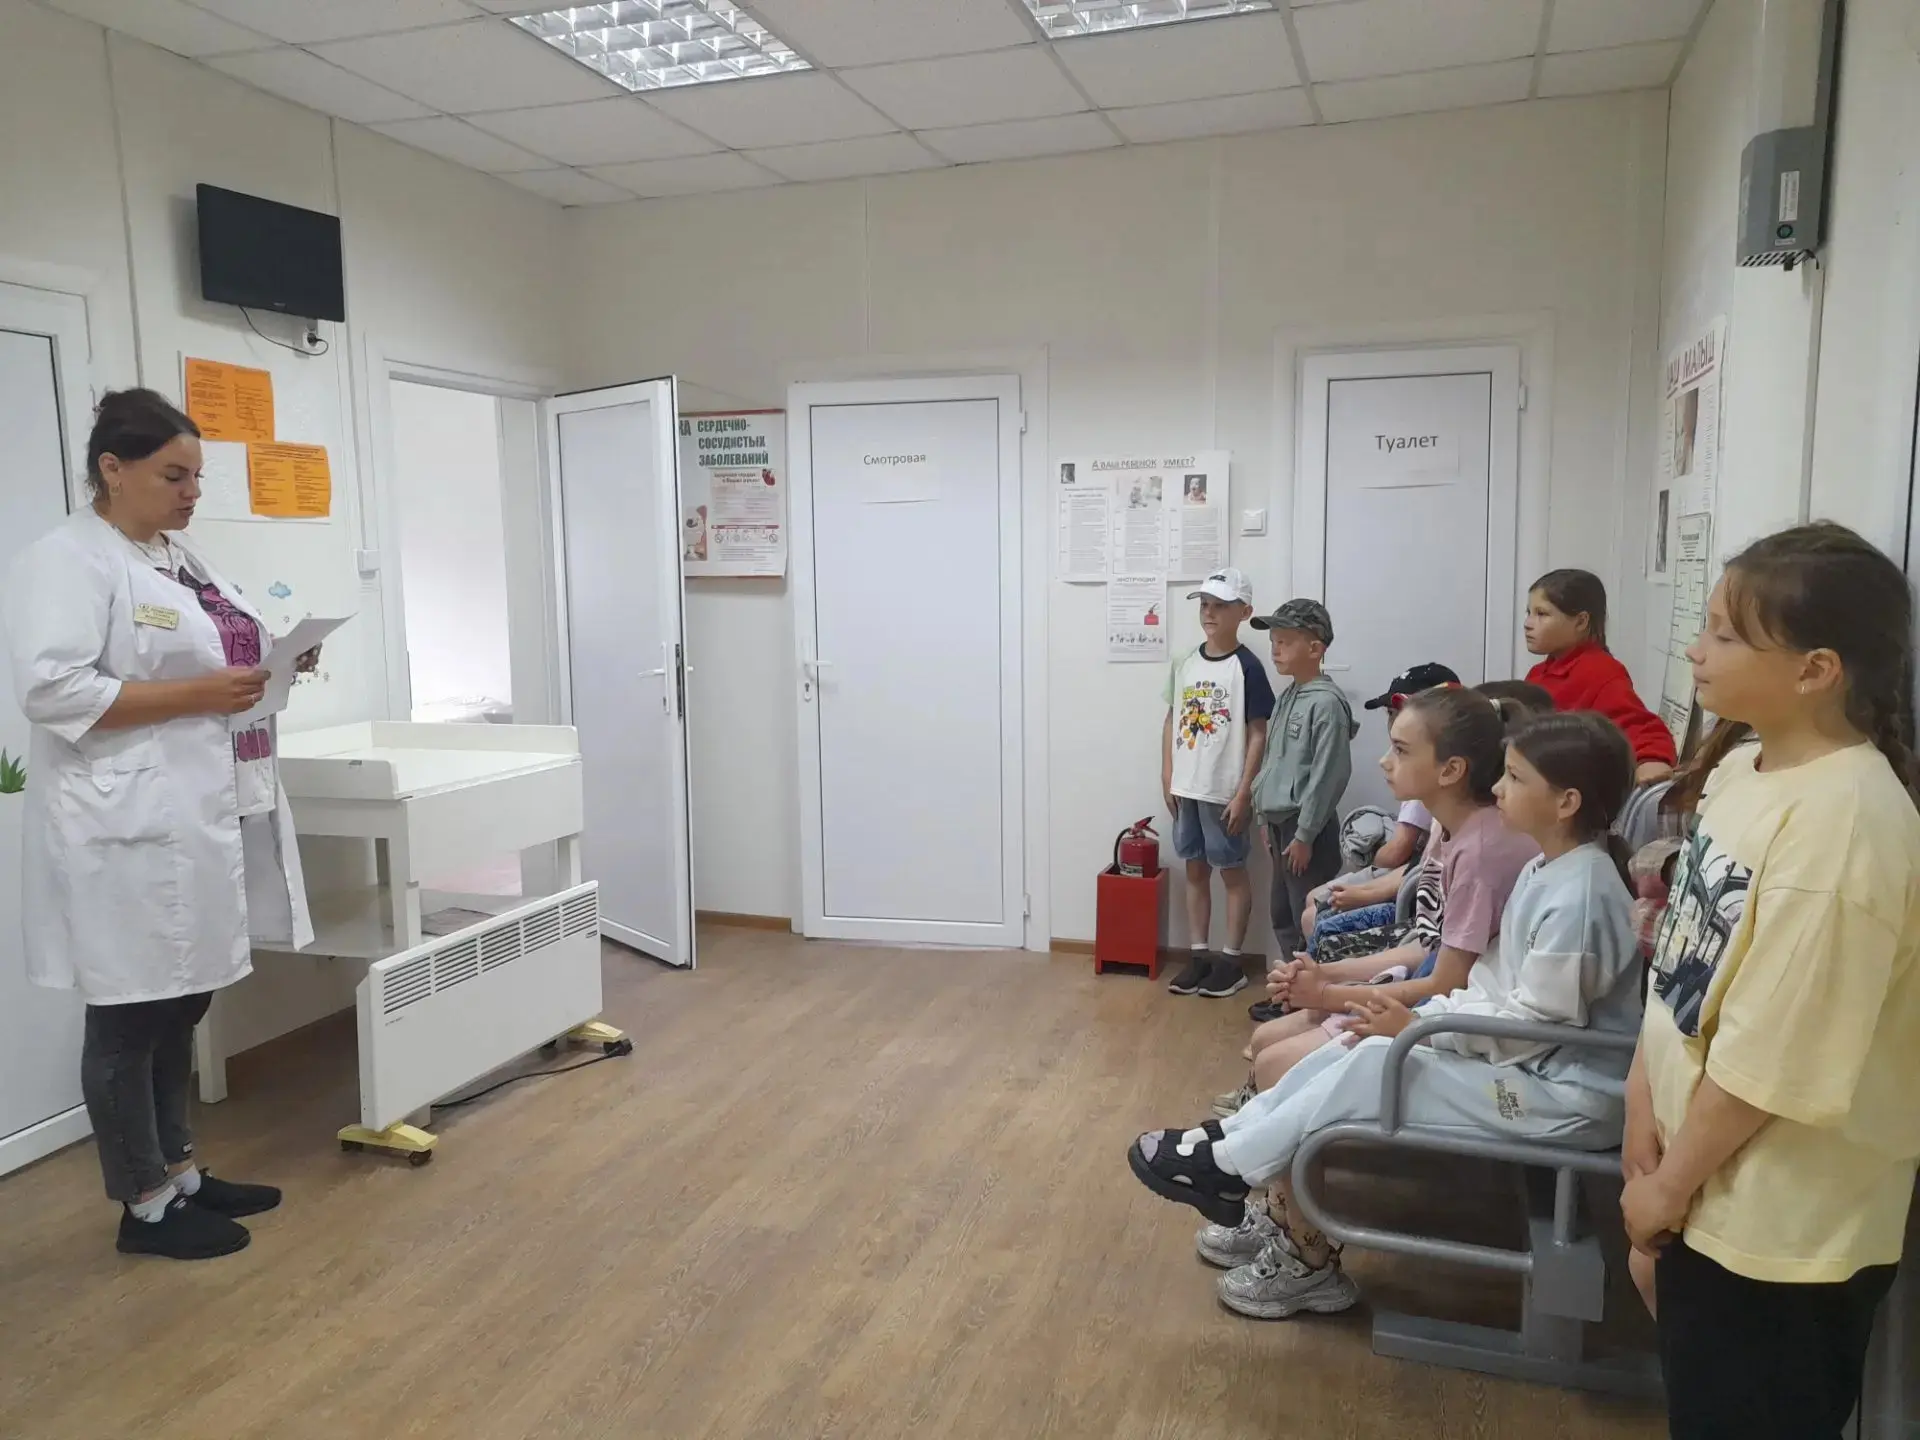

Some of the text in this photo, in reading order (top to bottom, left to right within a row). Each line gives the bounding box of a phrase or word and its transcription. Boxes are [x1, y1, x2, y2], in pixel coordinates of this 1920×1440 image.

[697, 418, 752, 433] СЕРДЕЧНО-
[698, 435, 766, 450] СОСУДИСТЫХ
[1374, 434, 1439, 453] Туалет
[698, 451, 769, 467] ЗАБОЛЕВАНИЙ
[863, 454, 926, 466] Смотровая
